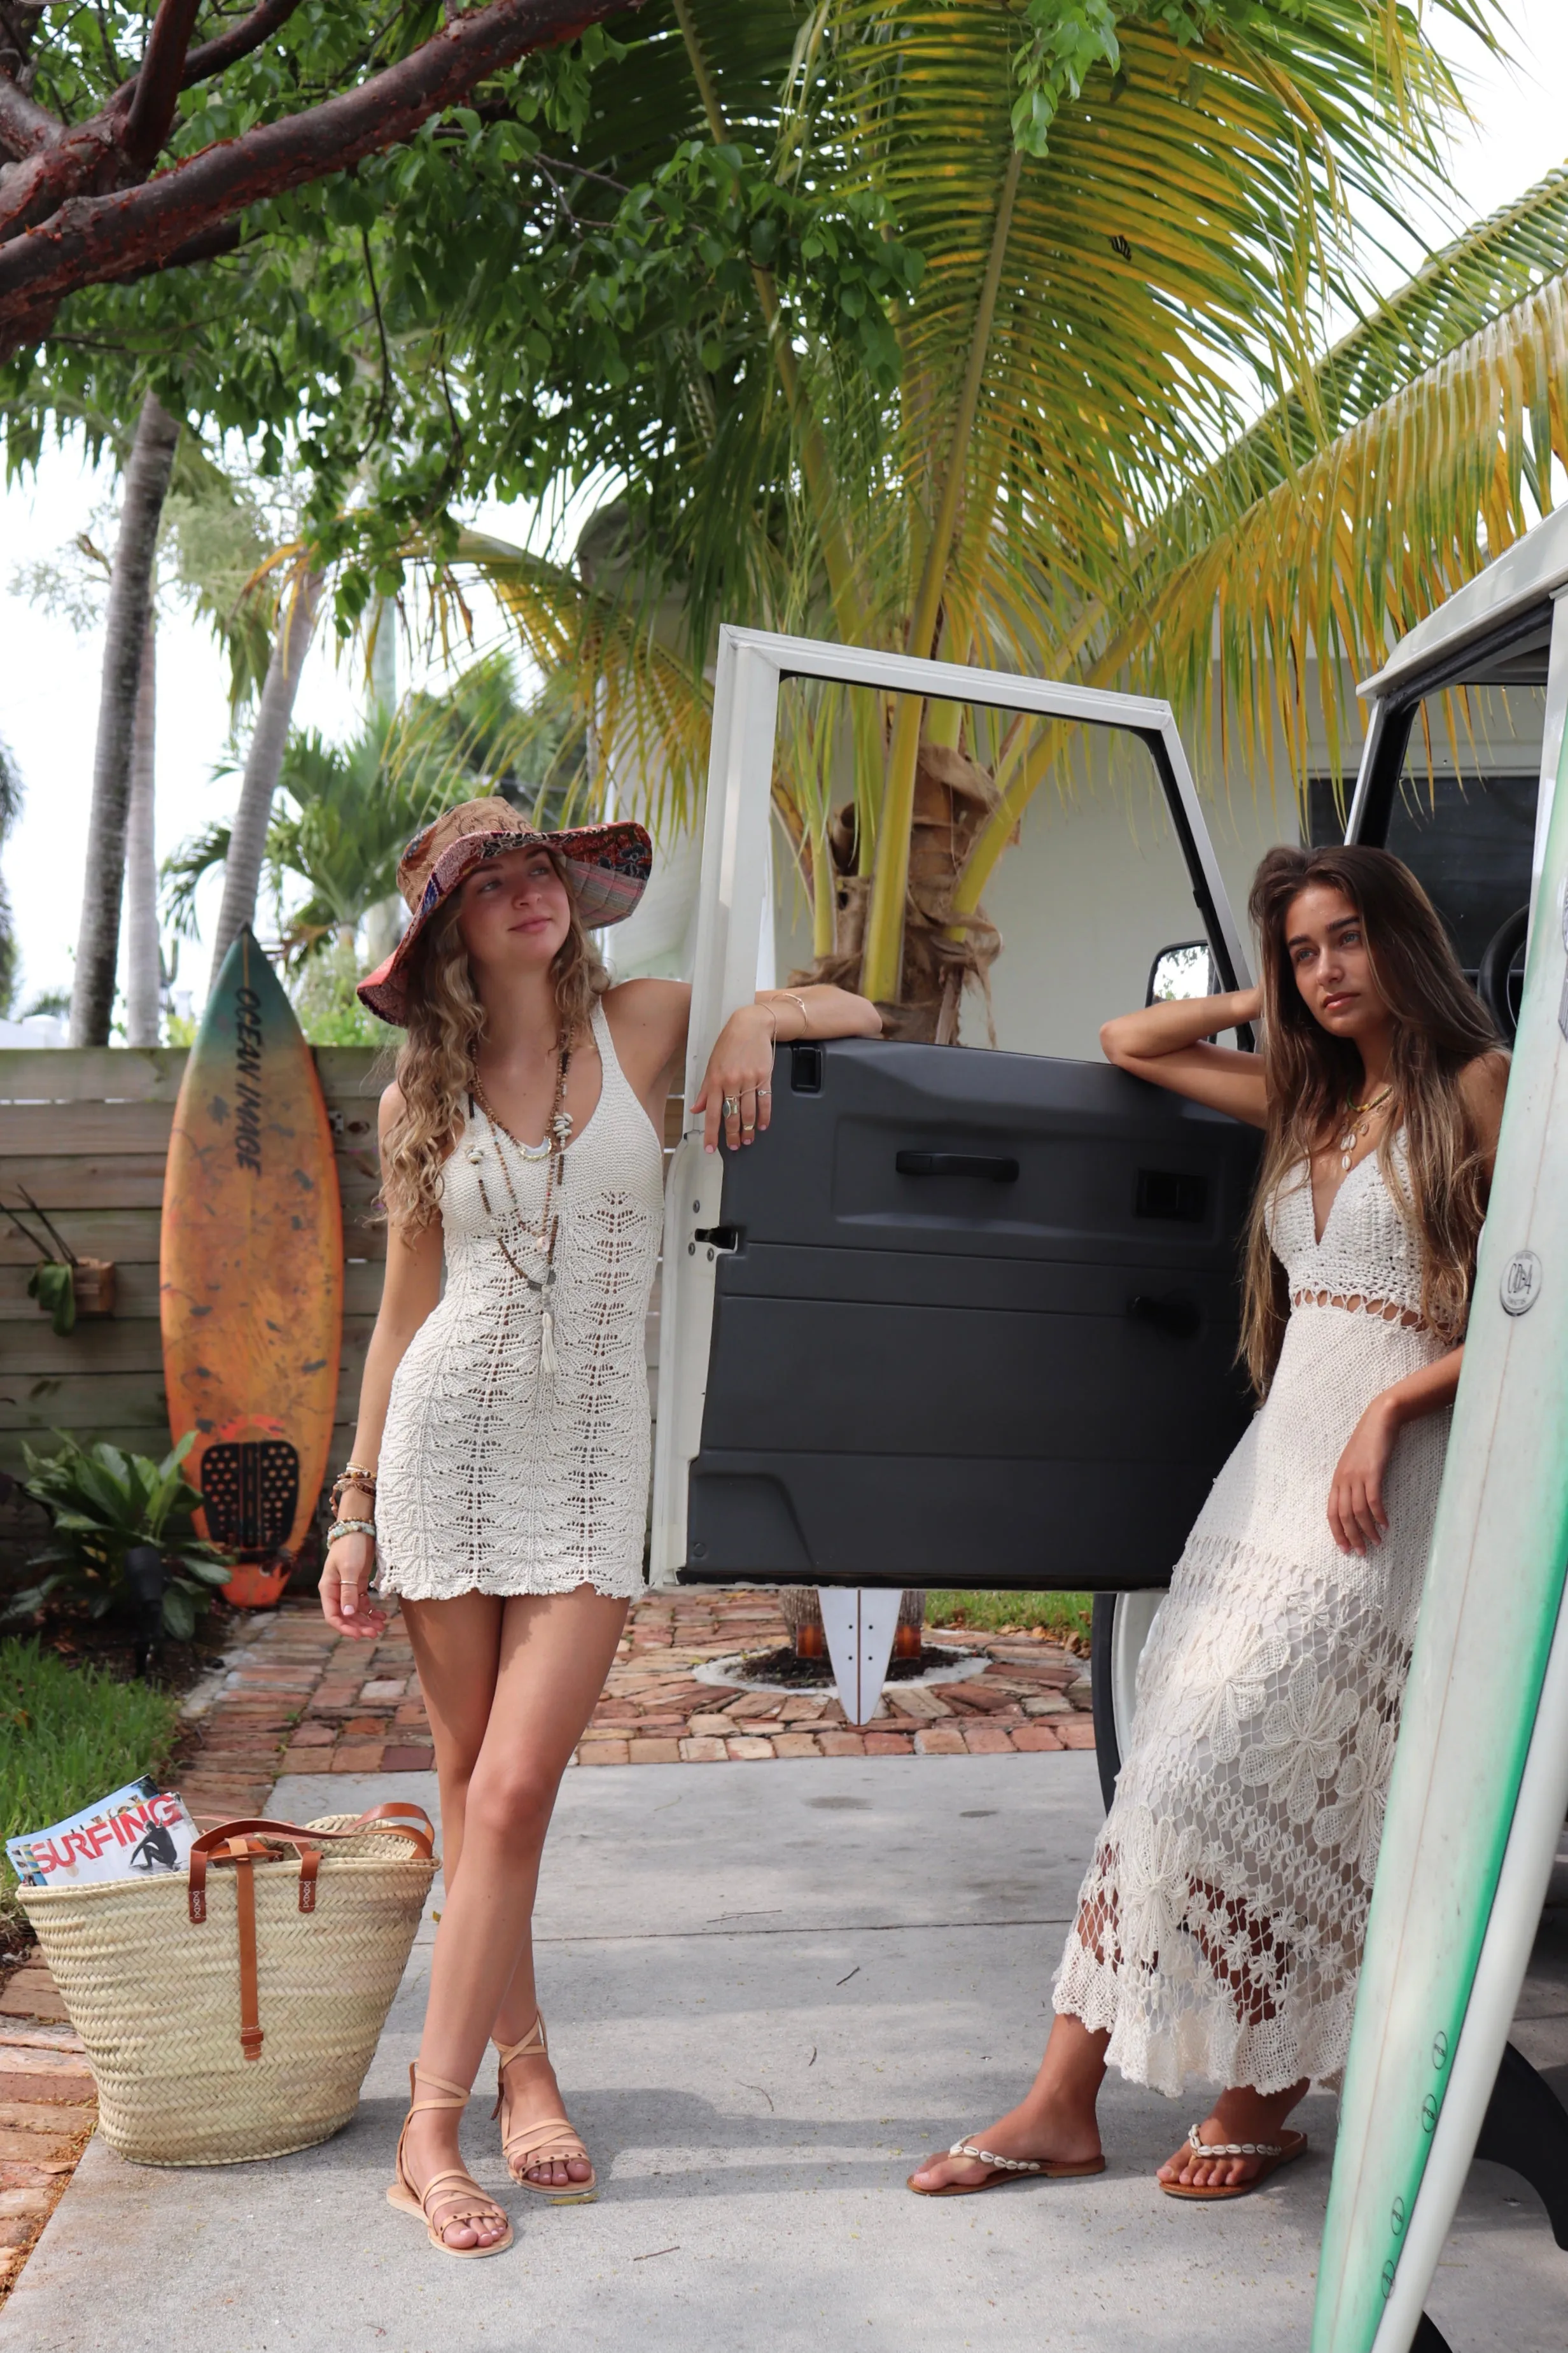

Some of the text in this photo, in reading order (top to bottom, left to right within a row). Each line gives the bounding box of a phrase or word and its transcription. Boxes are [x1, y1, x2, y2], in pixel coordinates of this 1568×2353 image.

[234, 988, 262, 1178] OCEAN IMAGE
[29, 1794, 184, 1874] SURFING
